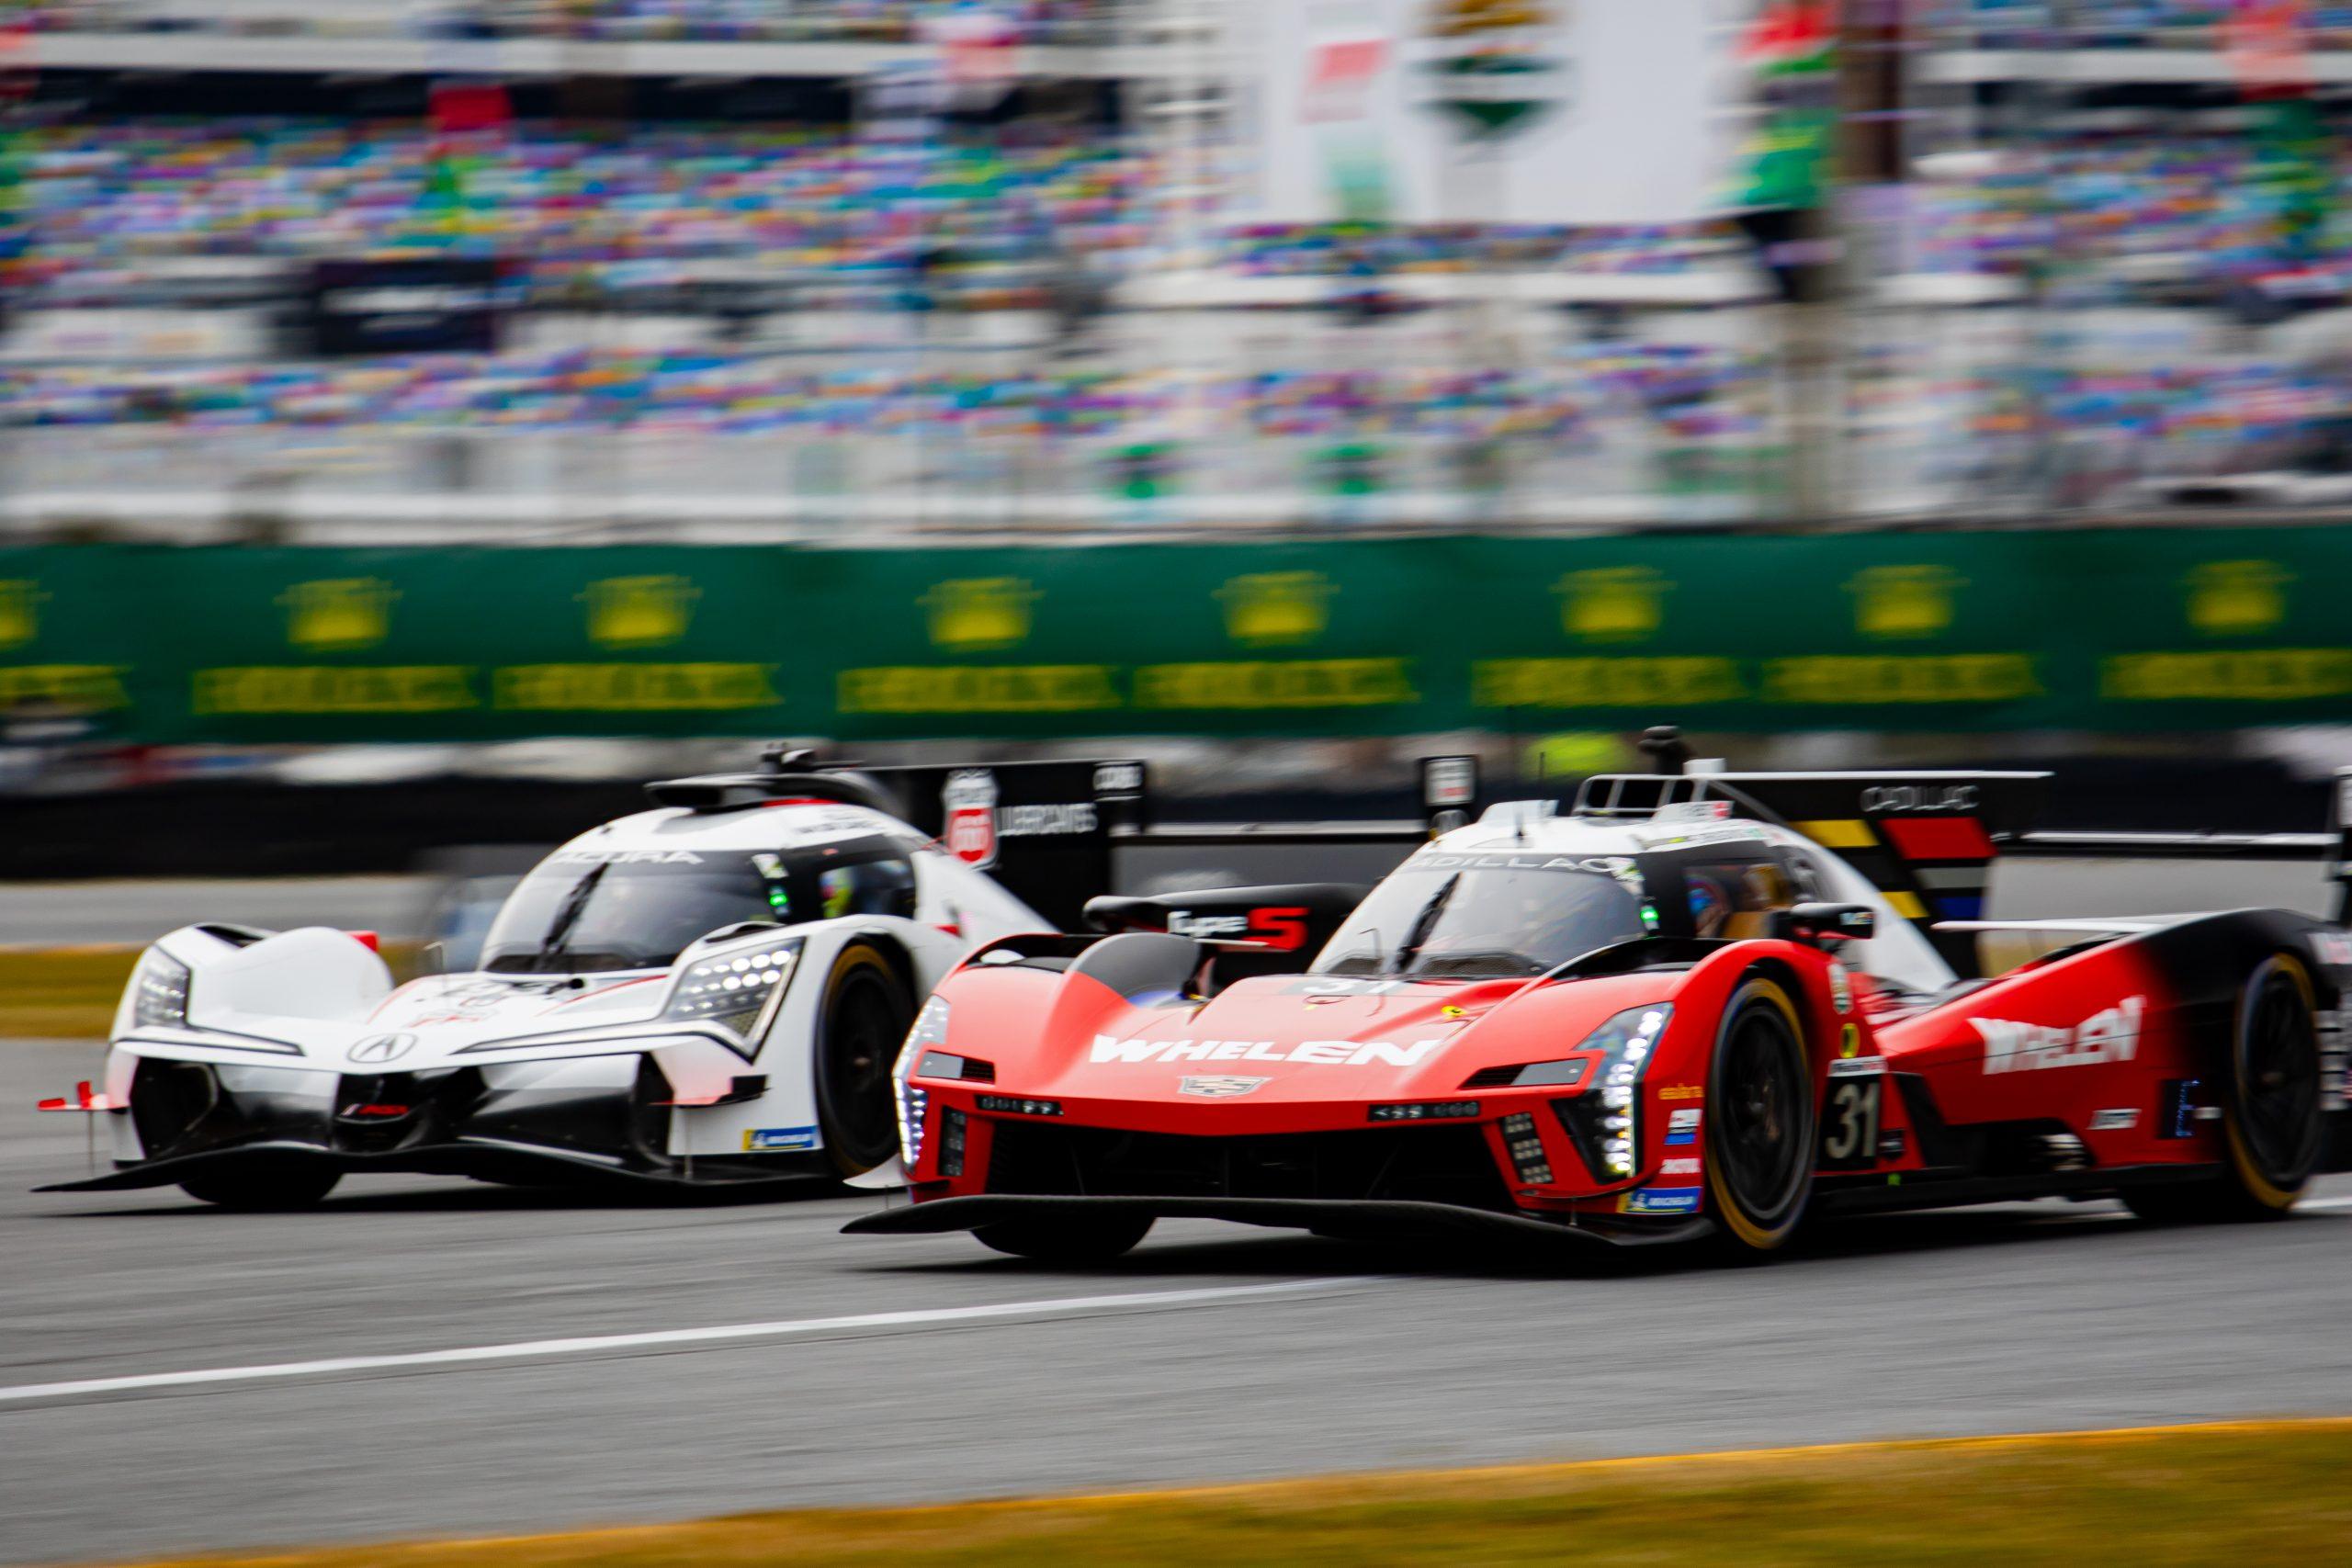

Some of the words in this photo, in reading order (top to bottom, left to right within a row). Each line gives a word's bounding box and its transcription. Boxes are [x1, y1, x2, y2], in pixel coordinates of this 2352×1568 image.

[1242, 907, 1309, 951] S
[1089, 1033, 1442, 1066] WHELEN
[1965, 995, 2147, 1075] WHELEN
[1825, 1082, 1881, 1159] 31
